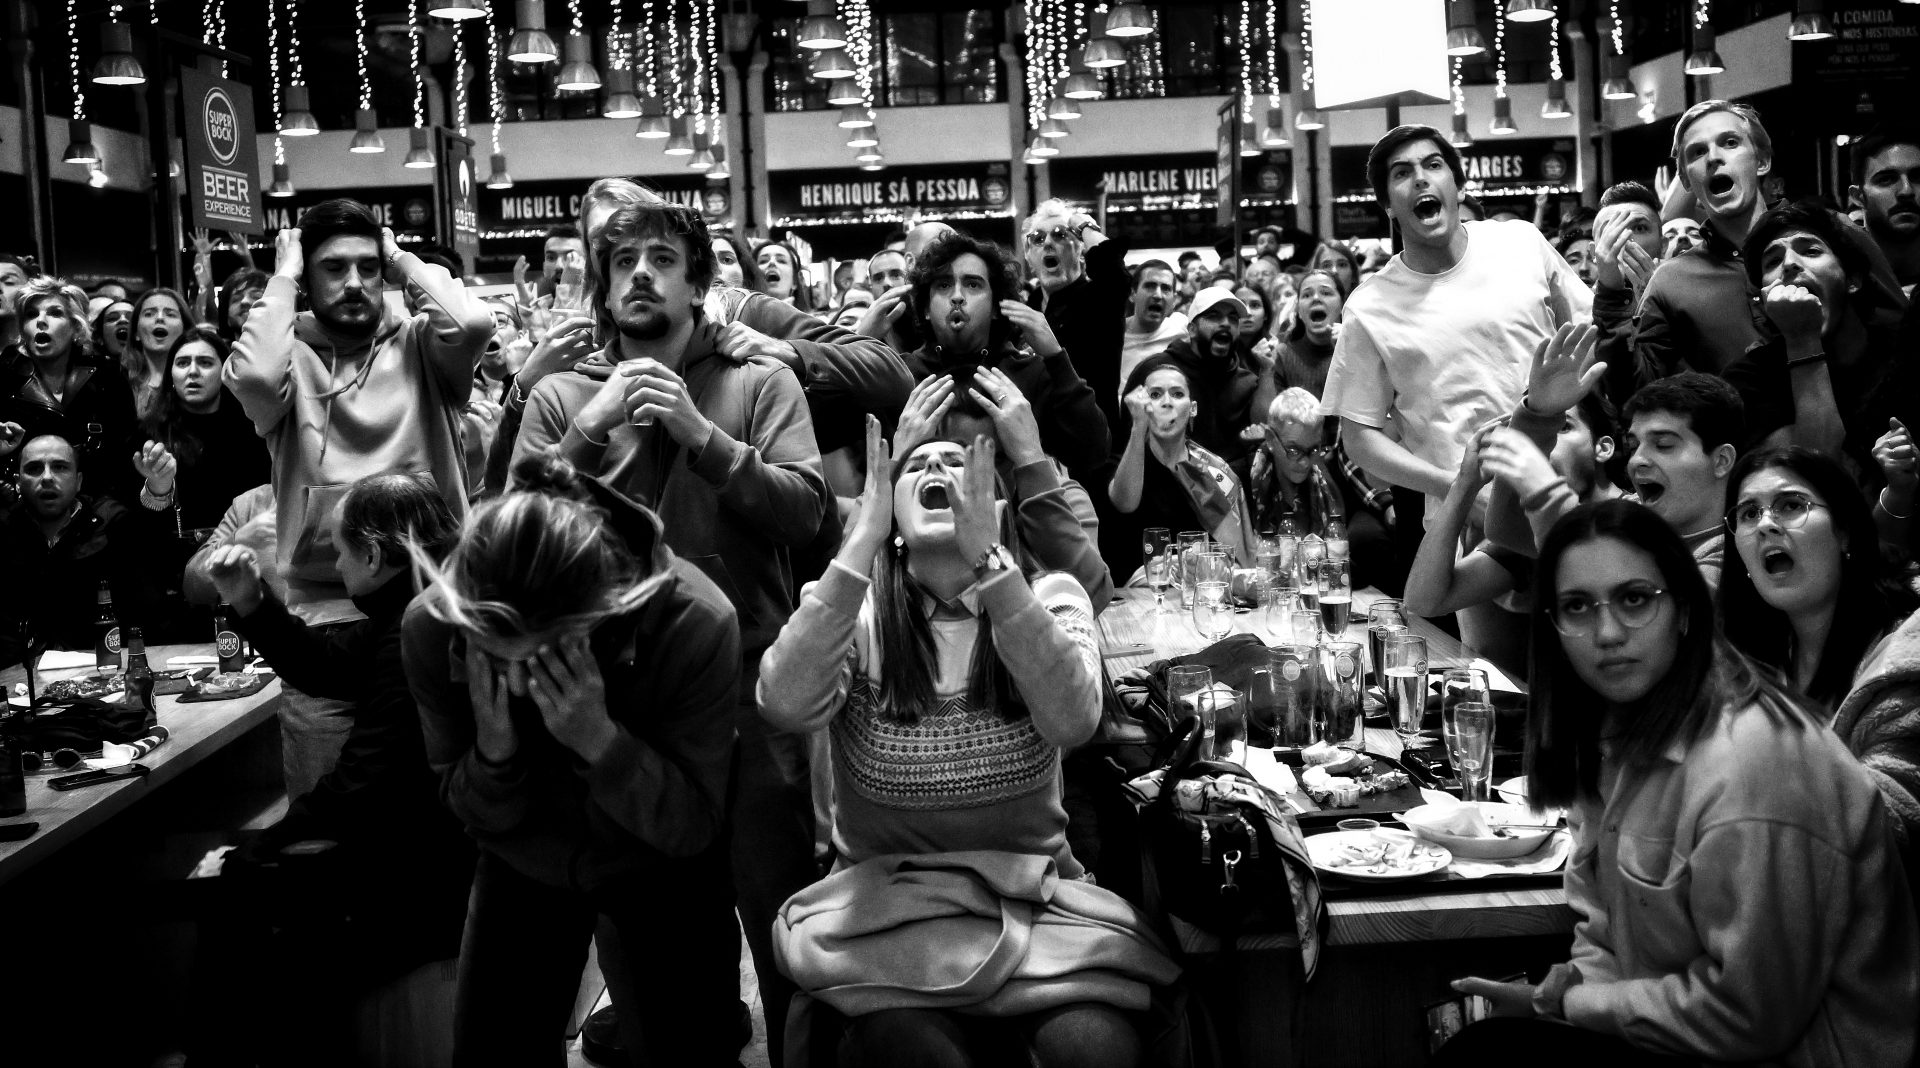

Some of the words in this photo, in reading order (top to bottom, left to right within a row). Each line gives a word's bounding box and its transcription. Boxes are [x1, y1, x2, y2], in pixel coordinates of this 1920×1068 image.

[1843, 9, 1894, 24] COMIDA
[209, 110, 232, 128] SUPER
[211, 125, 233, 142] BOCK
[1460, 155, 1523, 178] FARGES
[202, 171, 250, 203] BEER
[1103, 169, 1179, 193] MARLENE
[1184, 167, 1217, 190] VIEI
[801, 181, 884, 207] HENRIQUE
[888, 176, 911, 203] SÁ
[916, 177, 980, 202] PESSOA
[204, 199, 252, 217] EXPERIENCE
[262, 208, 291, 229] NA
[502, 196, 564, 220] MIGUEL
